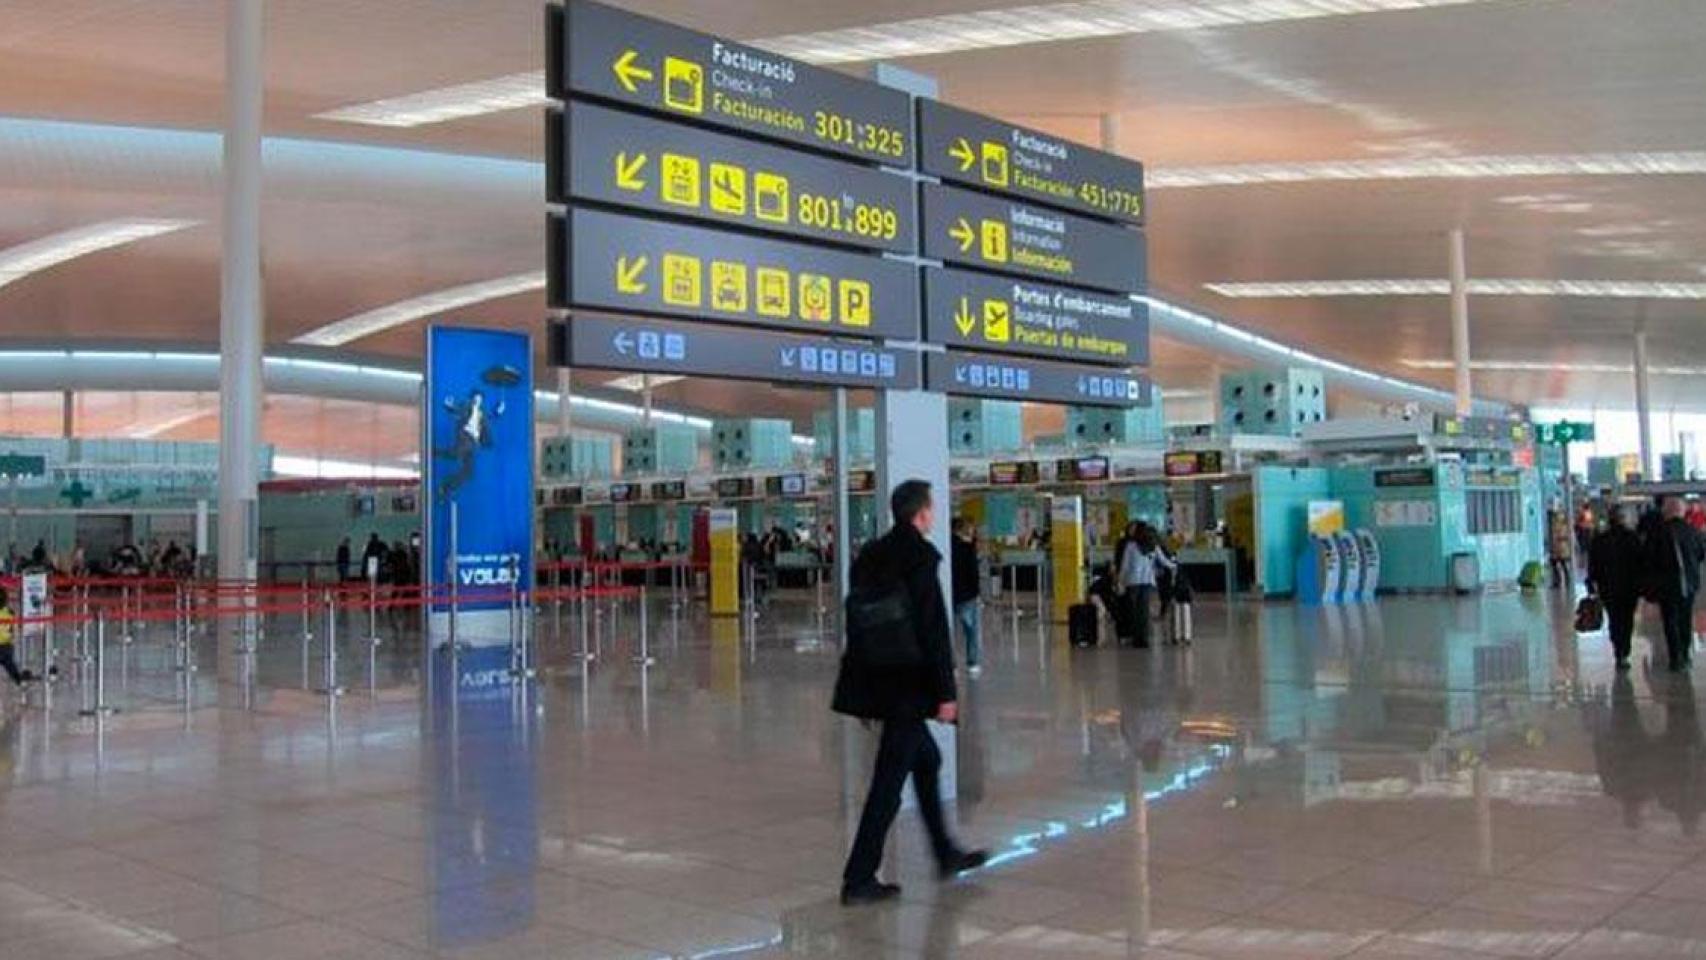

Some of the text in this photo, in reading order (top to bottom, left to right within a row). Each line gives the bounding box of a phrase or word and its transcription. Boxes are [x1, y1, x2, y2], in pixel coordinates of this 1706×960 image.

[713, 42, 796, 83] Facturació
[713, 91, 804, 131] Facturación
[815, 111, 853, 144] 301
[865, 124, 904, 156] 325
[799, 193, 842, 230] 801
[855, 204, 897, 239] 899
[847, 289, 863, 318] P
